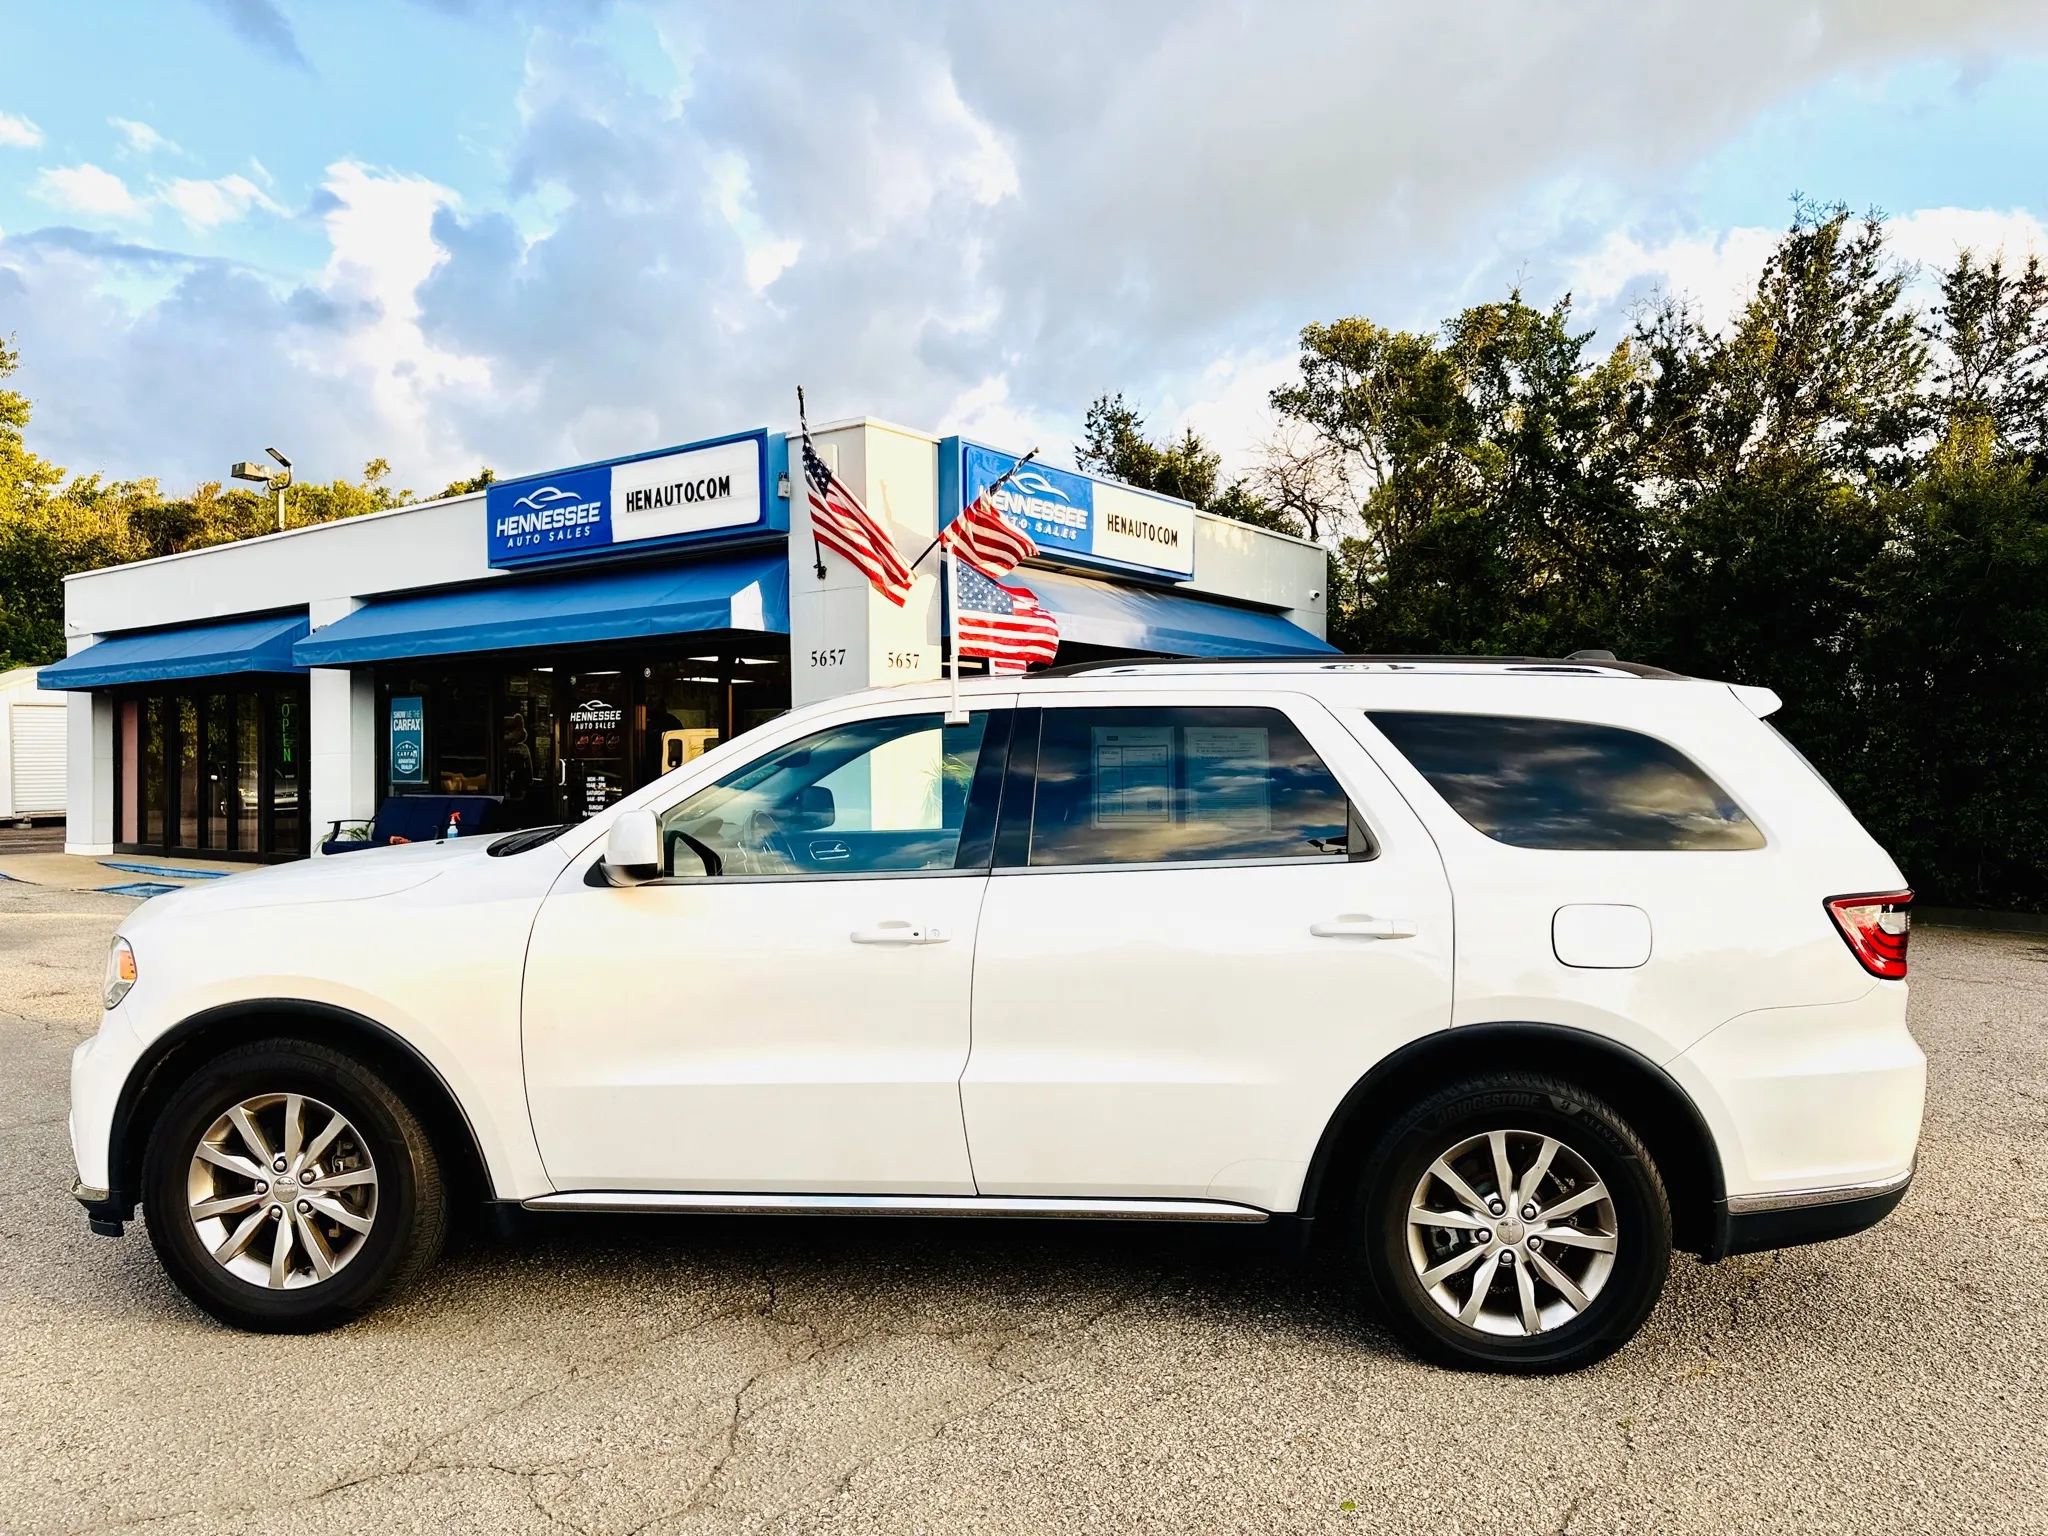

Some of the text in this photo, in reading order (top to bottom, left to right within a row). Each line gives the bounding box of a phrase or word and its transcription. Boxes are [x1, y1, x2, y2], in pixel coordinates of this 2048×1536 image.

[626, 475, 730, 513] HENAUTO.COM
[979, 485, 1089, 530] ENNESSEE
[496, 501, 601, 537] HENNESSEE
[507, 526, 591, 548] AUTO SALES
[1035, 522, 1078, 541] SALES
[811, 648, 846, 667] 5657
[888, 651, 920, 669] 5657
[394, 719, 420, 731] CARFAX
[570, 710, 622, 722] HENNESSEE
[575, 721, 616, 730] AUTO SALES
[281, 703, 291, 762] OPEN
